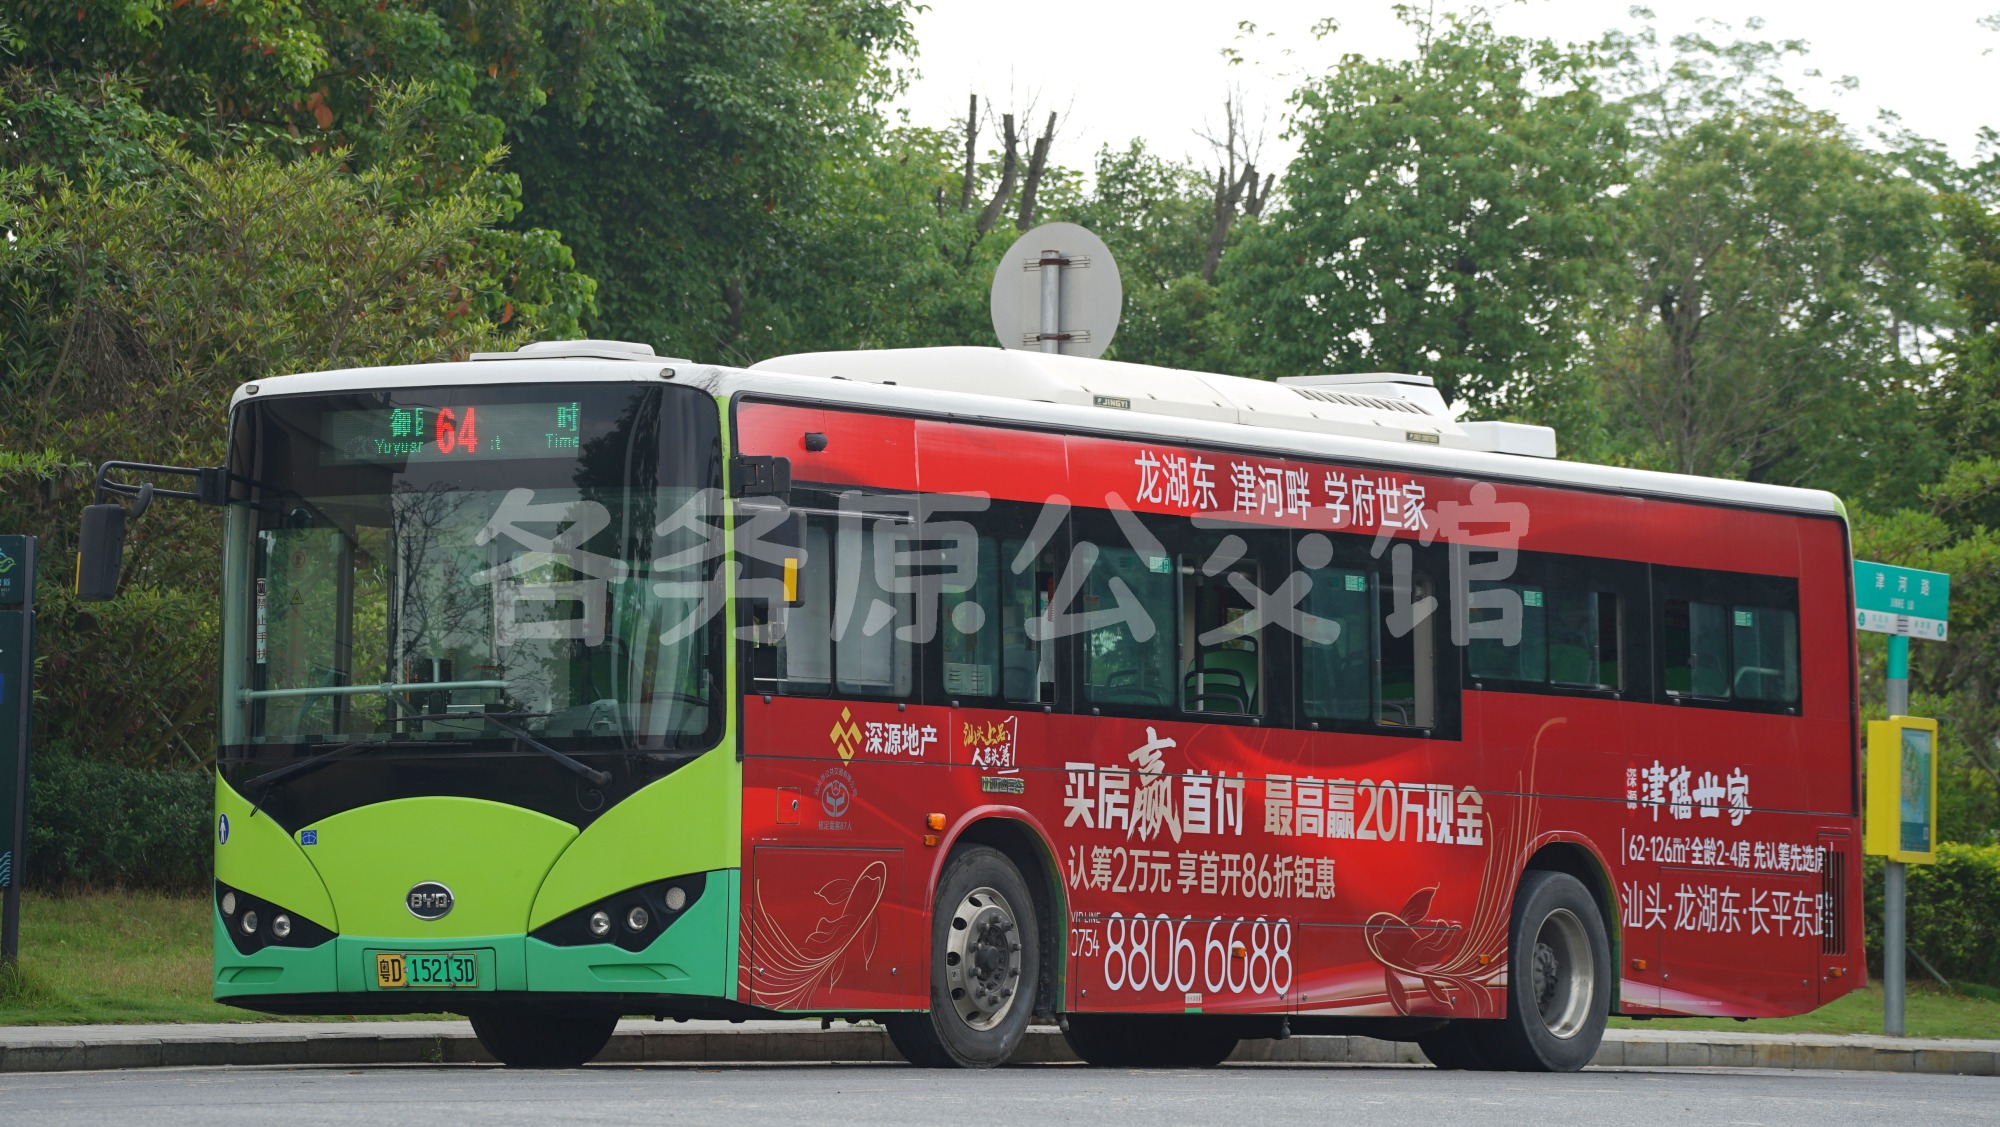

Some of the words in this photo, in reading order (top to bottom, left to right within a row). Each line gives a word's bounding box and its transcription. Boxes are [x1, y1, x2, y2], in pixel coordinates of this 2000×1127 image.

[1103, 397, 1128, 408] JINGYI
[436, 406, 478, 454] 64
[1134, 450, 1218, 510] 龙湖东
[1230, 461, 1312, 522] 津河畔
[1324, 471, 1429, 531] 学府世家
[864, 720, 938, 757] 深源地产
[1063, 726, 1246, 844] 买房赢首付
[1264, 773, 1484, 847] 最高赢20万现金
[1626, 768, 1638, 810] 深源
[1641, 759, 1753, 827] 津禧世家
[1067, 845, 1172, 894] 认筹2万元
[1176, 849, 1336, 900] 享首开86折钜惠
[410, 893, 449, 909] BYD
[1070, 911, 1083, 923] VIP
[1084, 911, 1101, 924] LINE
[1071, 928, 1100, 957] 0754
[411, 958, 475, 983] 15213D
